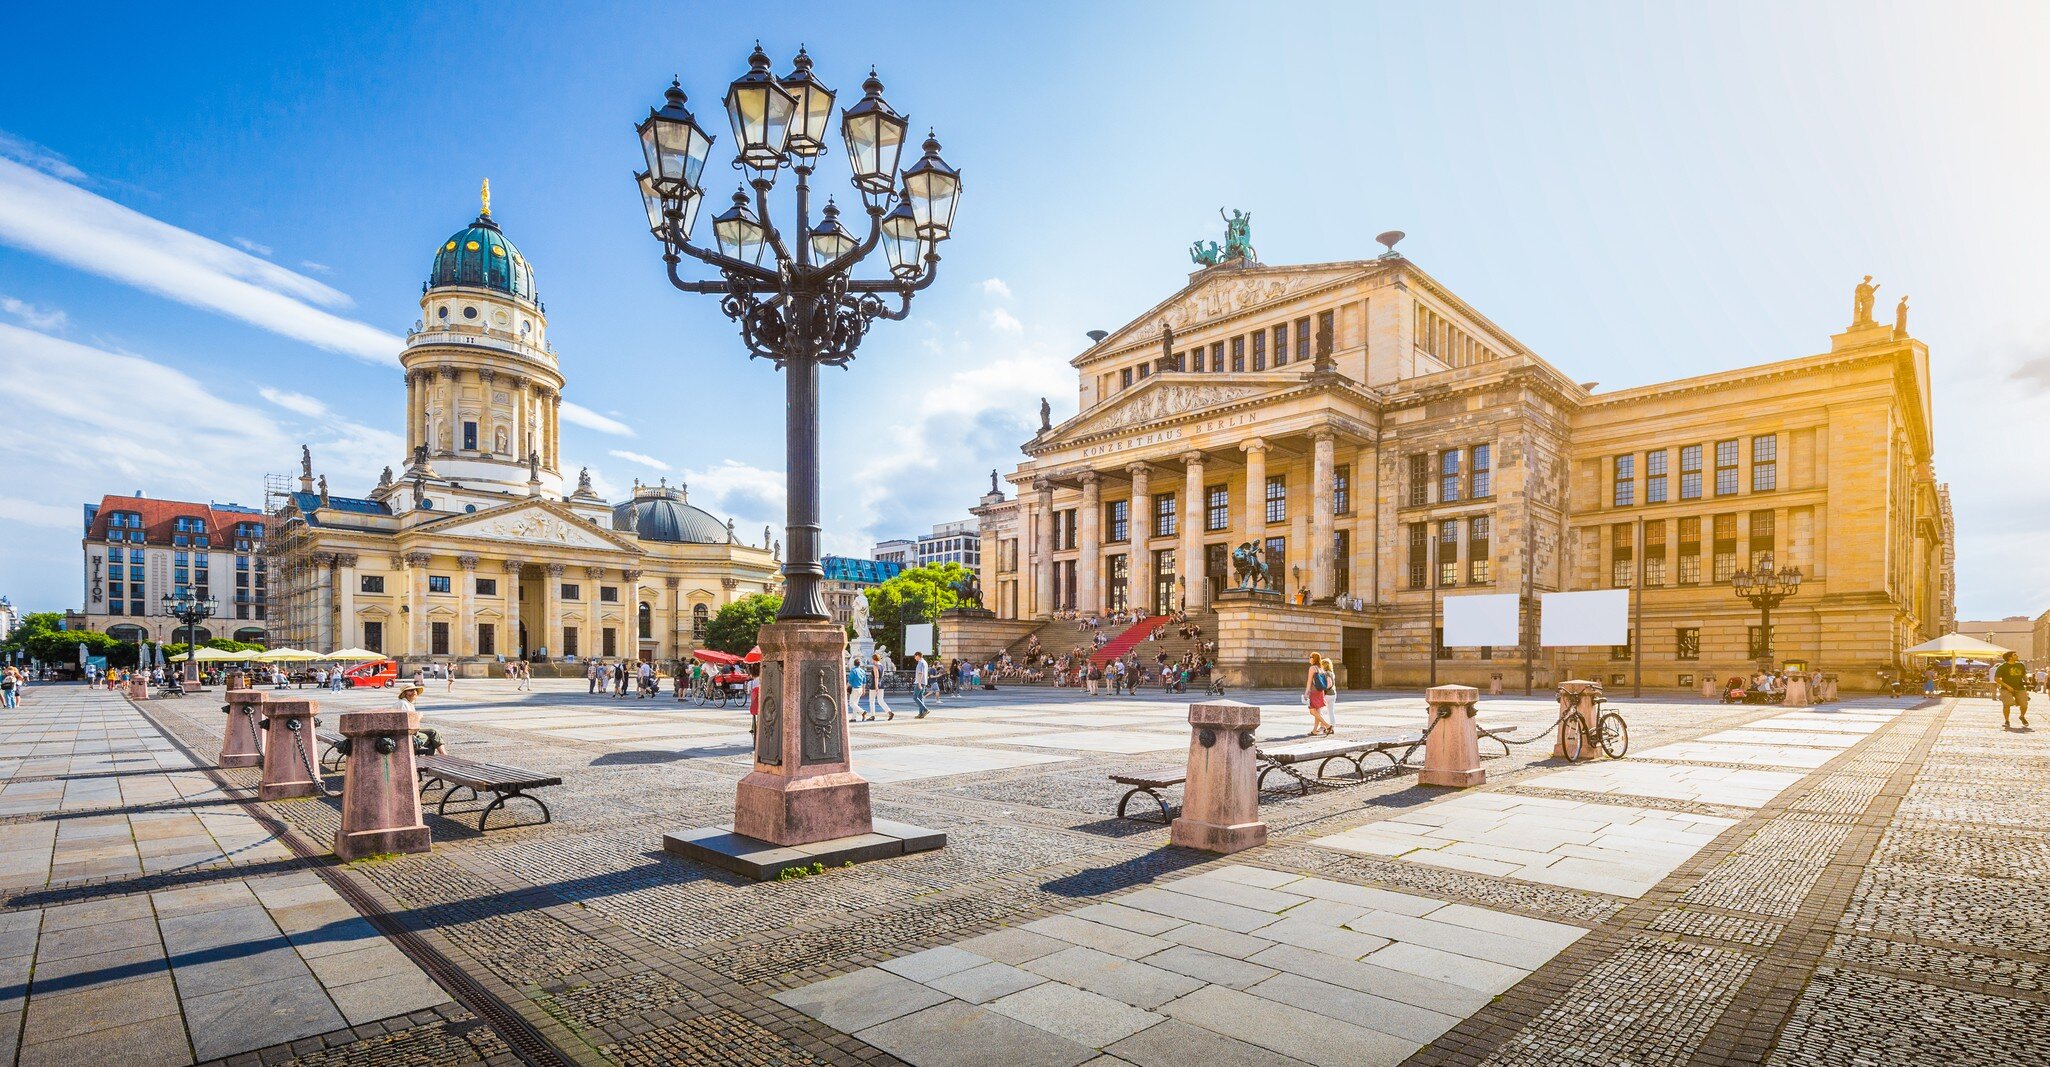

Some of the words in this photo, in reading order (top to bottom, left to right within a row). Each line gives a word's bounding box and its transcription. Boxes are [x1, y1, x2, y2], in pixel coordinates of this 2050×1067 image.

[1083, 428, 1182, 457] KONZERTHAUS
[1196, 412, 1257, 434] BERLIN
[92, 555, 103, 603] HILTON
